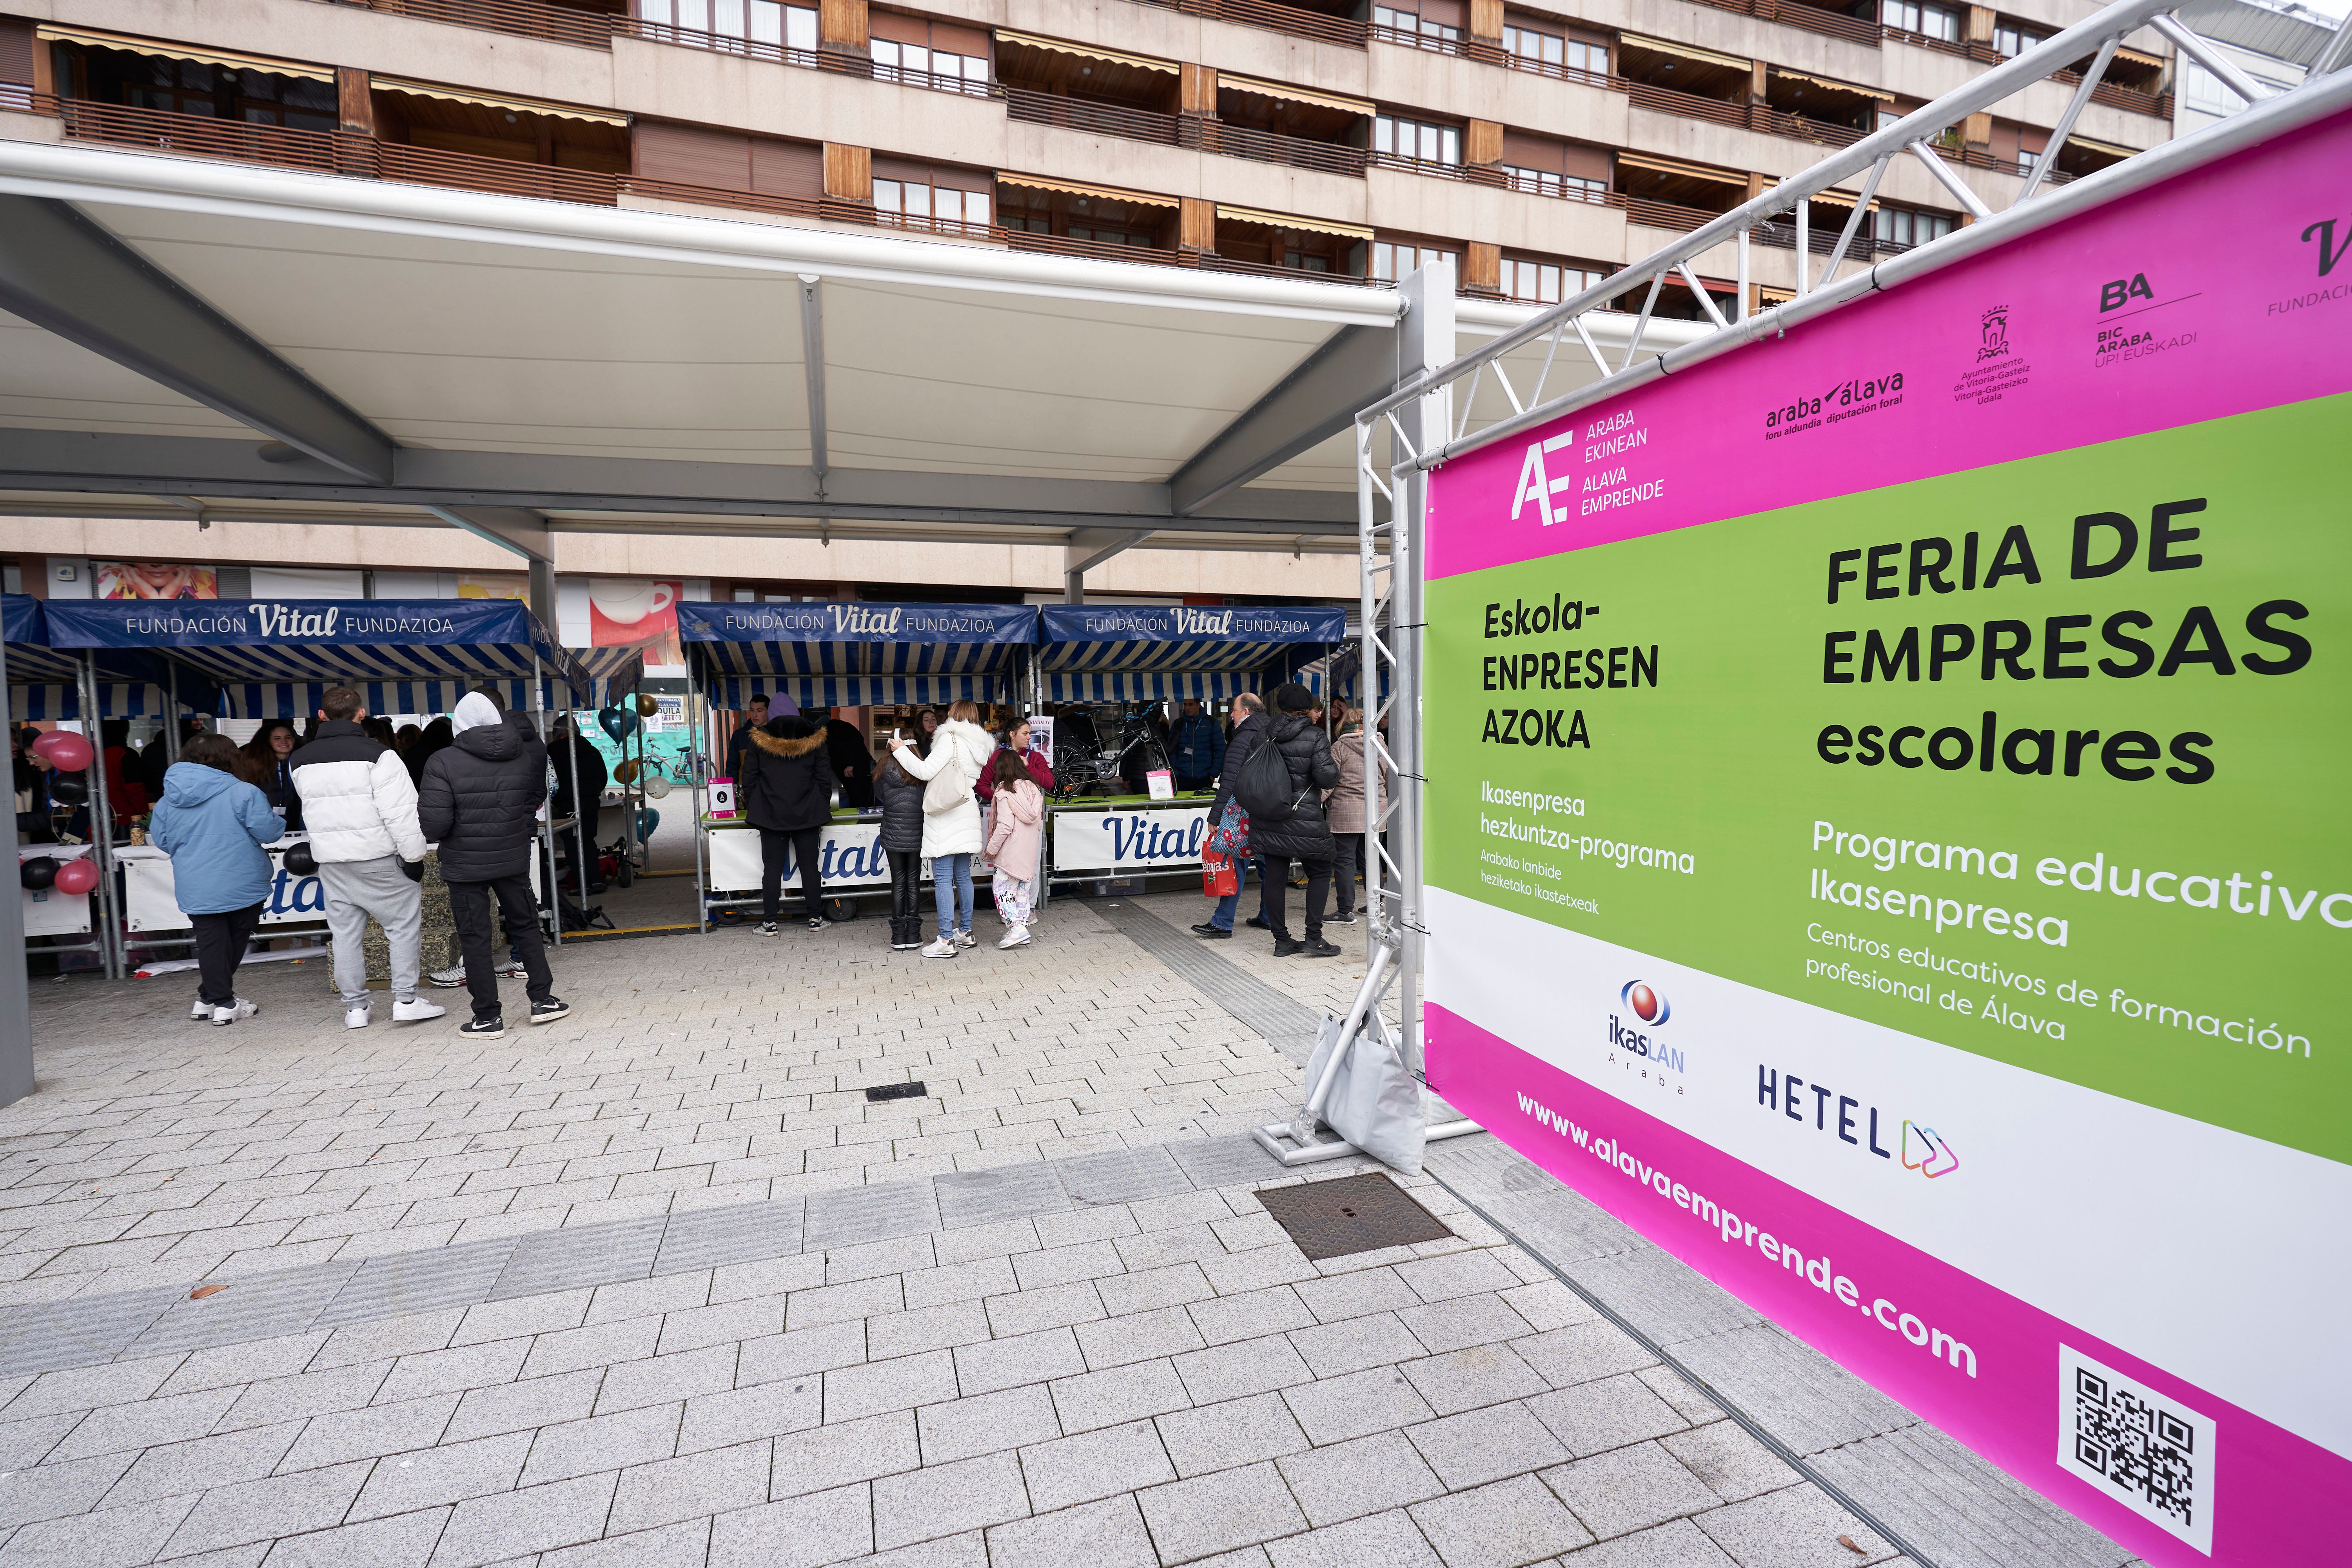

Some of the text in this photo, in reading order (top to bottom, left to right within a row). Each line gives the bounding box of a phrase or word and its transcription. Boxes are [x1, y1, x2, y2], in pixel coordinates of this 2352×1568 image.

[2100, 273, 2153, 313] BA
[2268, 285, 2352, 316] FUNDACI
[2095, 332, 2196, 368] UP! EUSKADI
[2096, 332, 2152, 355] ARABA
[2098, 327, 2122, 342] BIC
[1962, 358, 2023, 380] Ayuntamiento
[1967, 366, 2030, 388] Vitoria-Gasteiz
[1767, 373, 1903, 427] araba álava
[1955, 378, 2027, 401] Vitoria-Gasteizko
[1978, 393, 2001, 405] Udala
[1586, 410, 1634, 441] ARABA
[1766, 394, 1902, 440] foru aldundia diputación foral
[1586, 428, 1646, 463] EKINEAN
[1582, 467, 1626, 494] ALAVA
[1582, 479, 1664, 515] EMPRENDE
[1828, 498, 2207, 604] FERIA DE
[127, 604, 453, 636] FUNDACIÓN Vital FUNDAZIOA
[726, 605, 994, 633] FUNDACIÓN Vital FUNDAZIOA
[1087, 608, 1309, 634] FUNDACIÓN Vital FUNDAZIOA
[1485, 593, 1599, 638] Eskola-
[1824, 600, 2312, 683] EMPRESAS
[1484, 645, 1658, 690] ENPRESEN
[1482, 709, 1590, 748] AZOKA
[1817, 711, 2214, 784] escolares
[1482, 781, 1584, 816] Ikasenpresa
[1102, 816, 1204, 861] Vital
[1481, 812, 1694, 874] hezkuntza-programa
[1202, 859, 1229, 875] ebajas
[1481, 849, 1561, 880] Arabako lanbide
[1814, 821, 2352, 928] Programa educativo
[1481, 869, 1599, 914] heziketako ikastetxeak
[1811, 869, 2068, 947] Ikasenpresa
[1807, 959, 2065, 1040] profesional de Álava
[1808, 923, 2310, 1057] Centros educativos de formación
[1759, 1064, 1890, 1159] HETEL
[1517, 1091, 1976, 1378] www.alavaemprende.com
